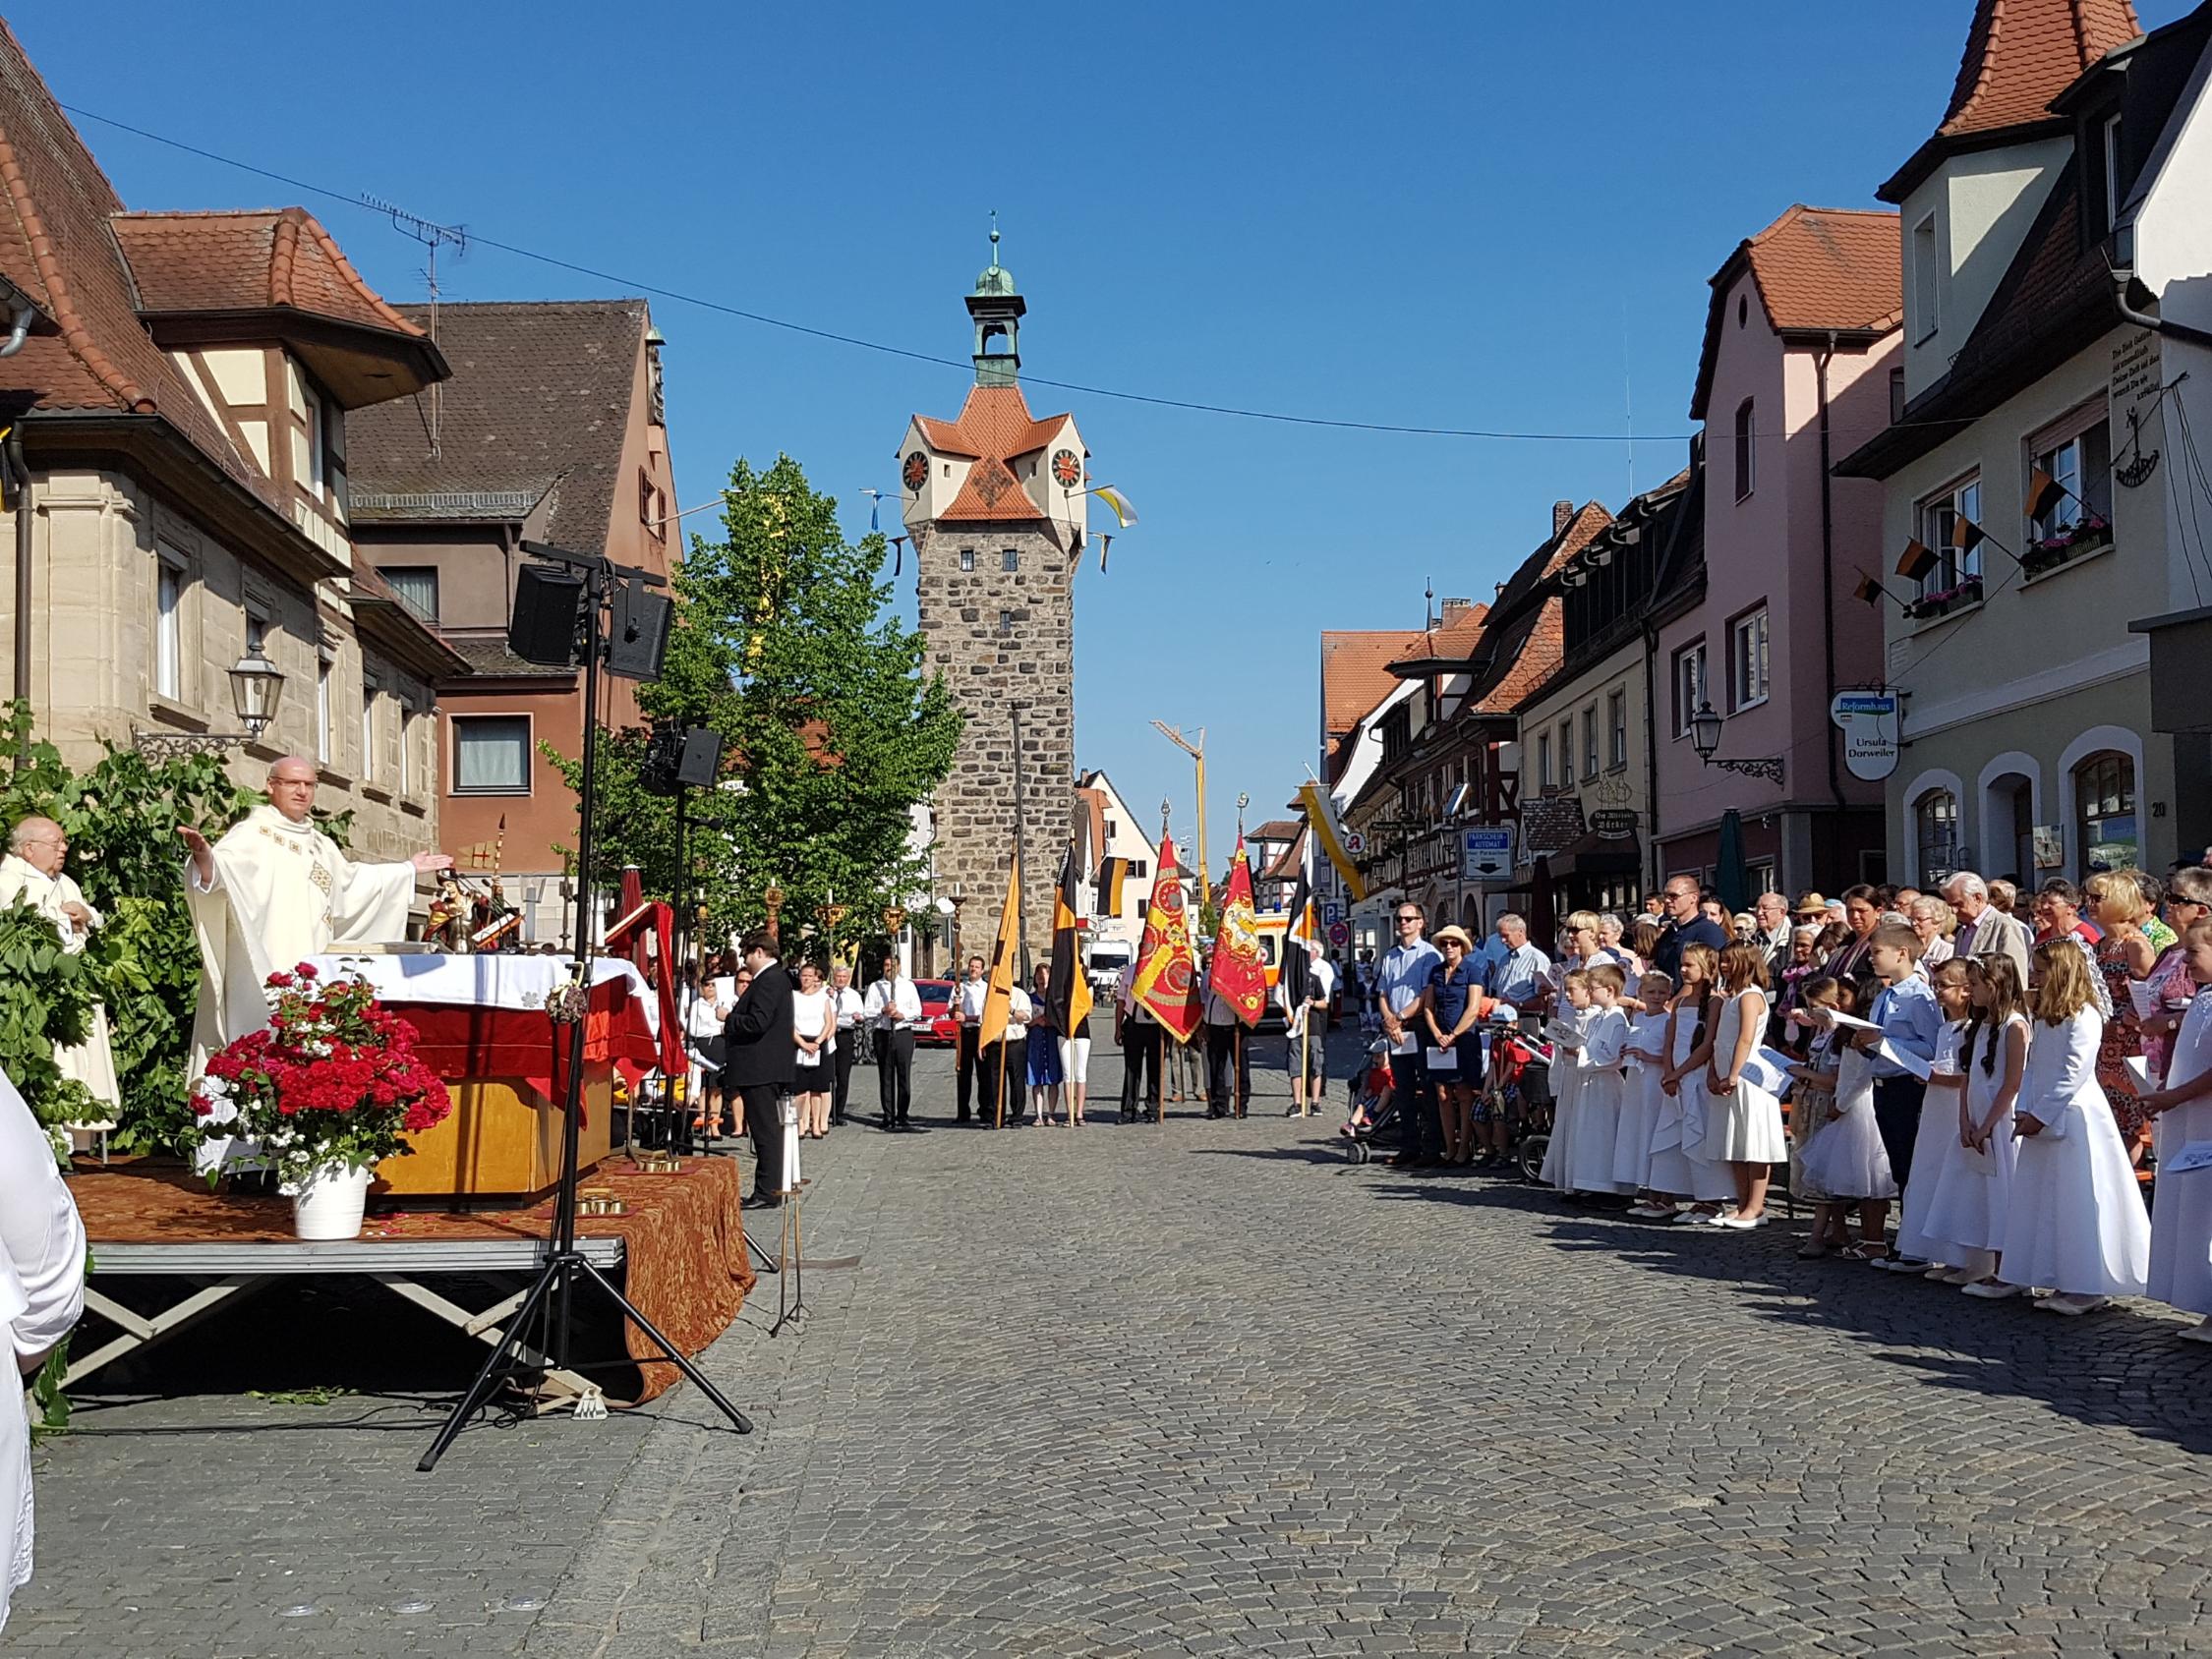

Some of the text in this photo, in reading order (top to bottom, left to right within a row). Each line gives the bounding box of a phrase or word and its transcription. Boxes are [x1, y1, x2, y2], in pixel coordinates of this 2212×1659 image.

[1841, 701, 1891, 713] Reformhaus
[1856, 737, 1887, 747] Ursula
[1848, 748, 1895, 758] Dorweiler
[2152, 802, 2166, 818] 20
[1326, 905, 1336, 923] P
